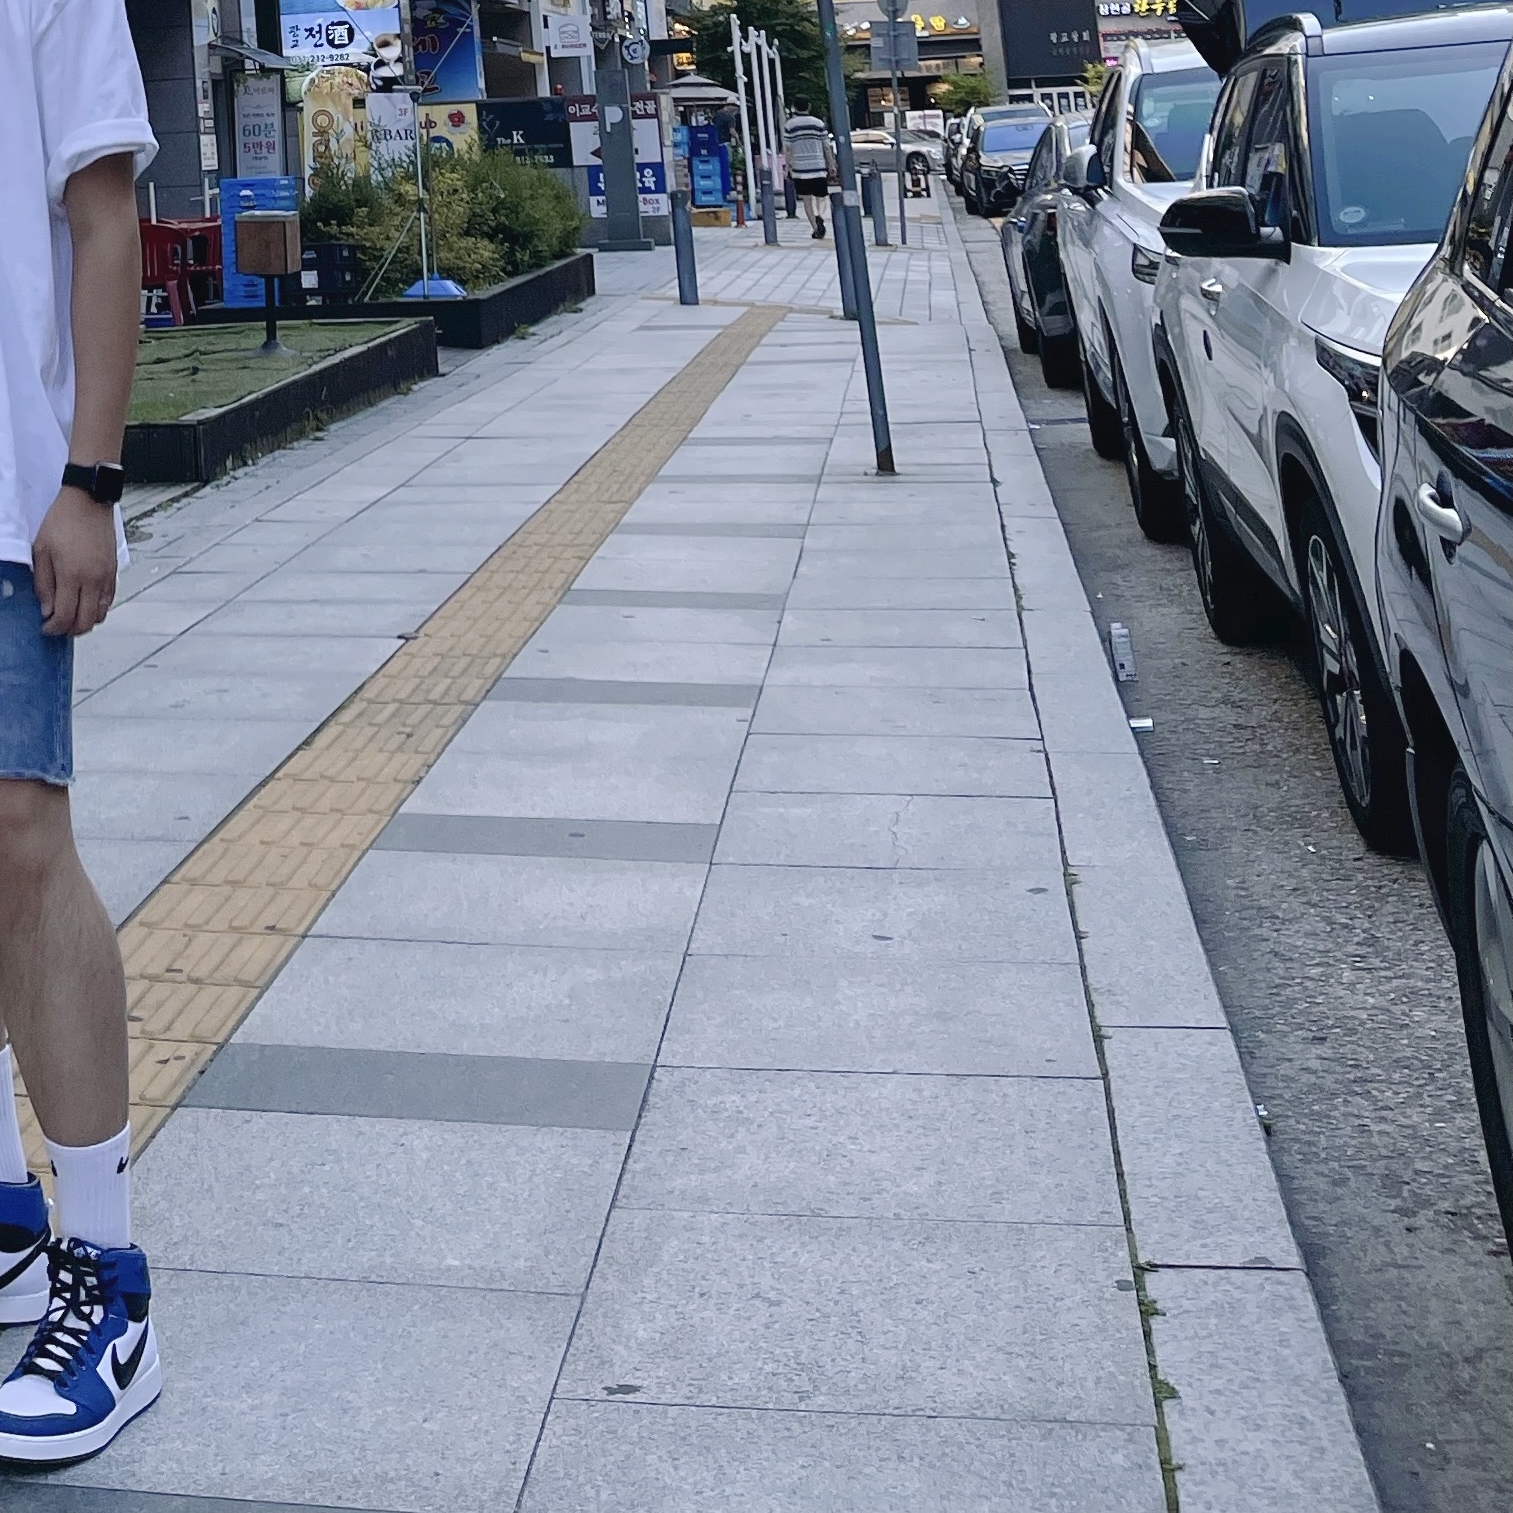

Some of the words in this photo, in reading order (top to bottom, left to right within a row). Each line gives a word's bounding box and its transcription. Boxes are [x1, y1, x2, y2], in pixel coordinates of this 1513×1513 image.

[289, 52, 351, 65] 031-212-9282
[397, 108, 409, 118] 3F
[604, 105, 624, 133] P
[242, 121, 277, 139] 60분
[383, 128, 415, 142] BAR
[512, 130, 526, 145] K
[242, 139, 277, 155] 5만원
